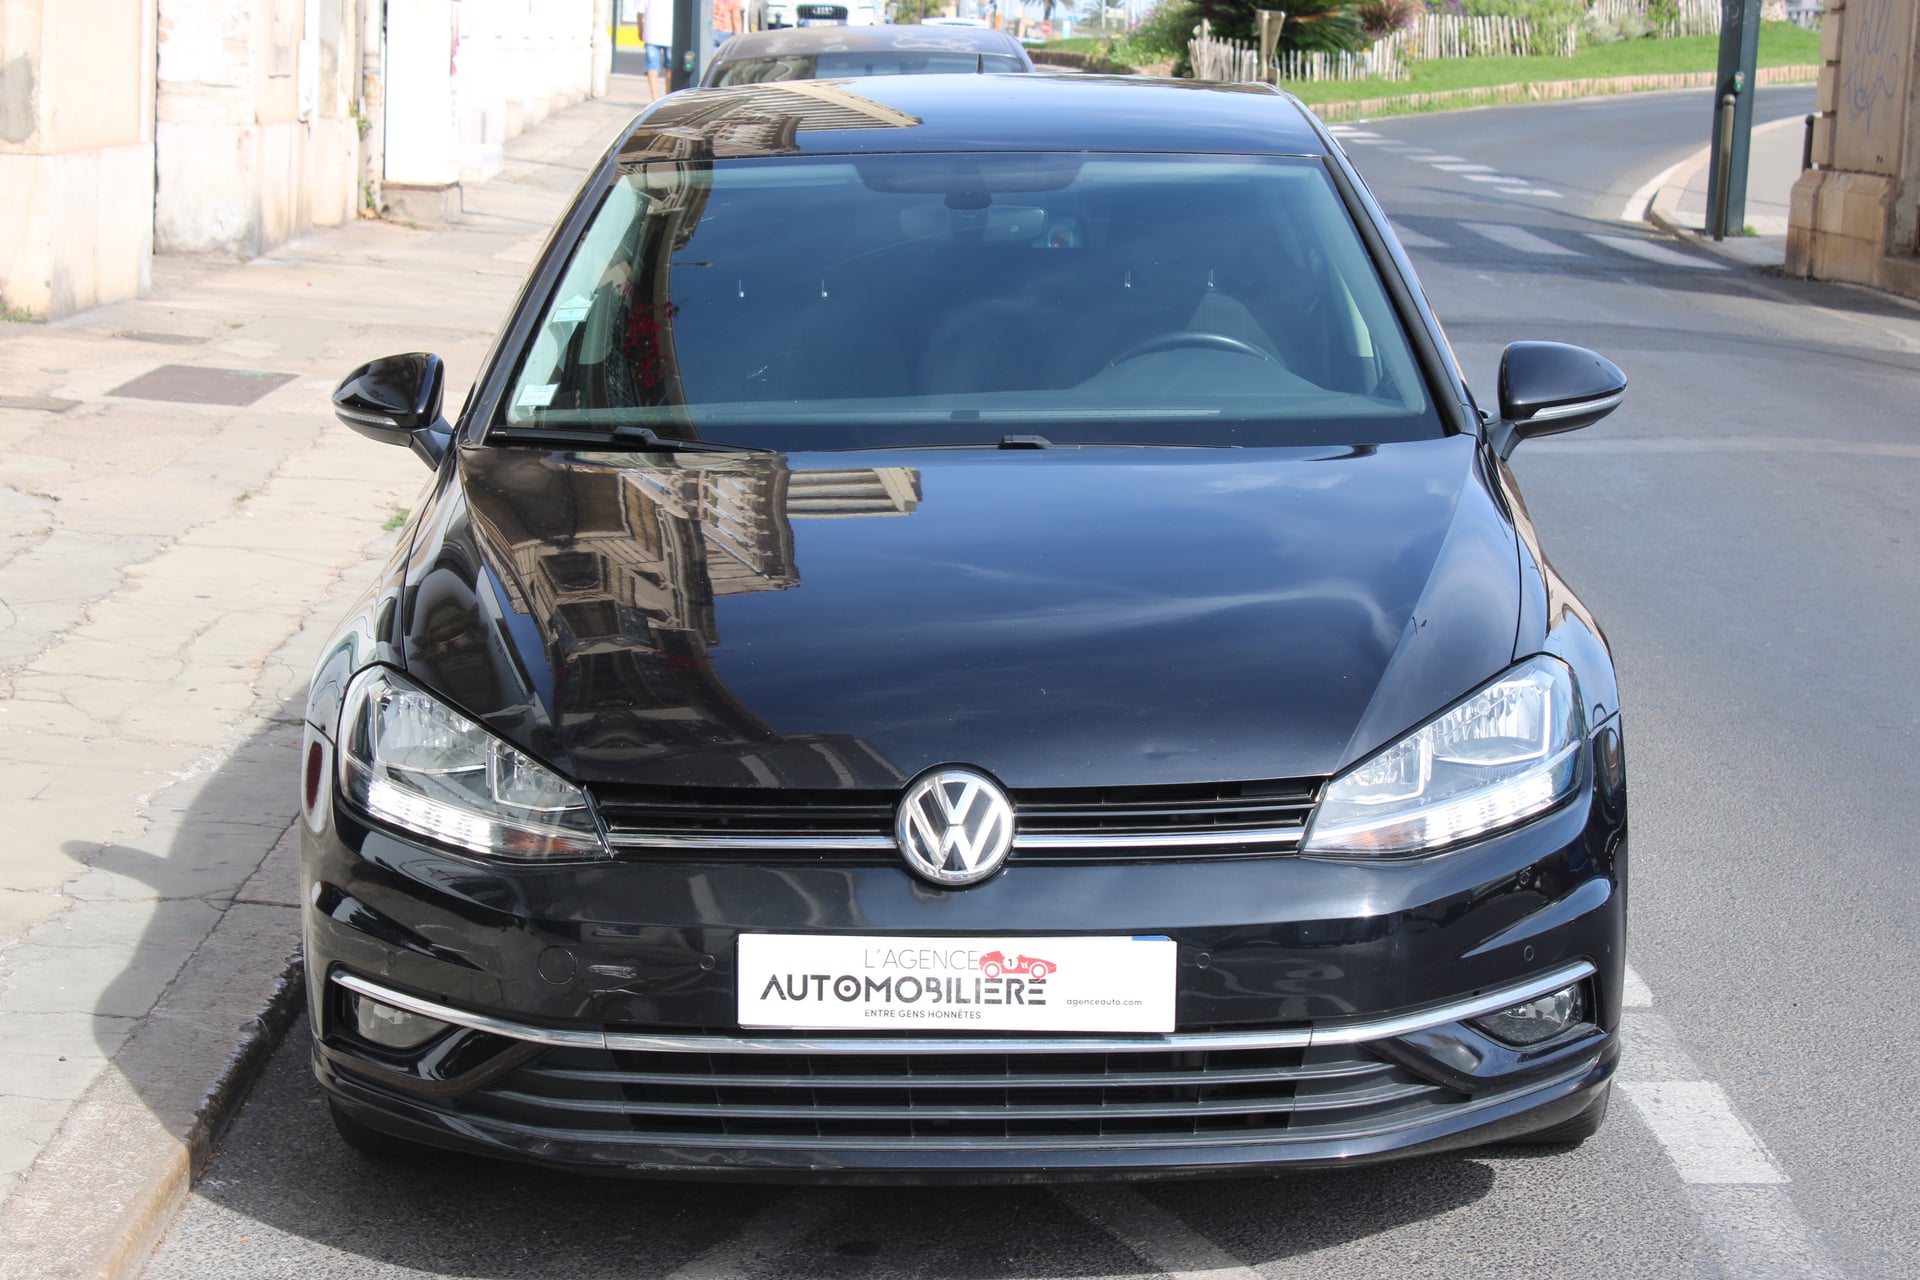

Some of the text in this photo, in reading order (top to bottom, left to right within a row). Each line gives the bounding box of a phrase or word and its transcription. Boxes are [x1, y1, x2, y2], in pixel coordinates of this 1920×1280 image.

[901, 774, 1008, 876] VW
[864, 948, 980, 970] L'AGENCE
[1007, 958, 1013, 968] 1
[1066, 998, 1142, 1008] agenceauto.com
[864, 1008, 981, 1019] ENTRE GENS HONNÊTES
